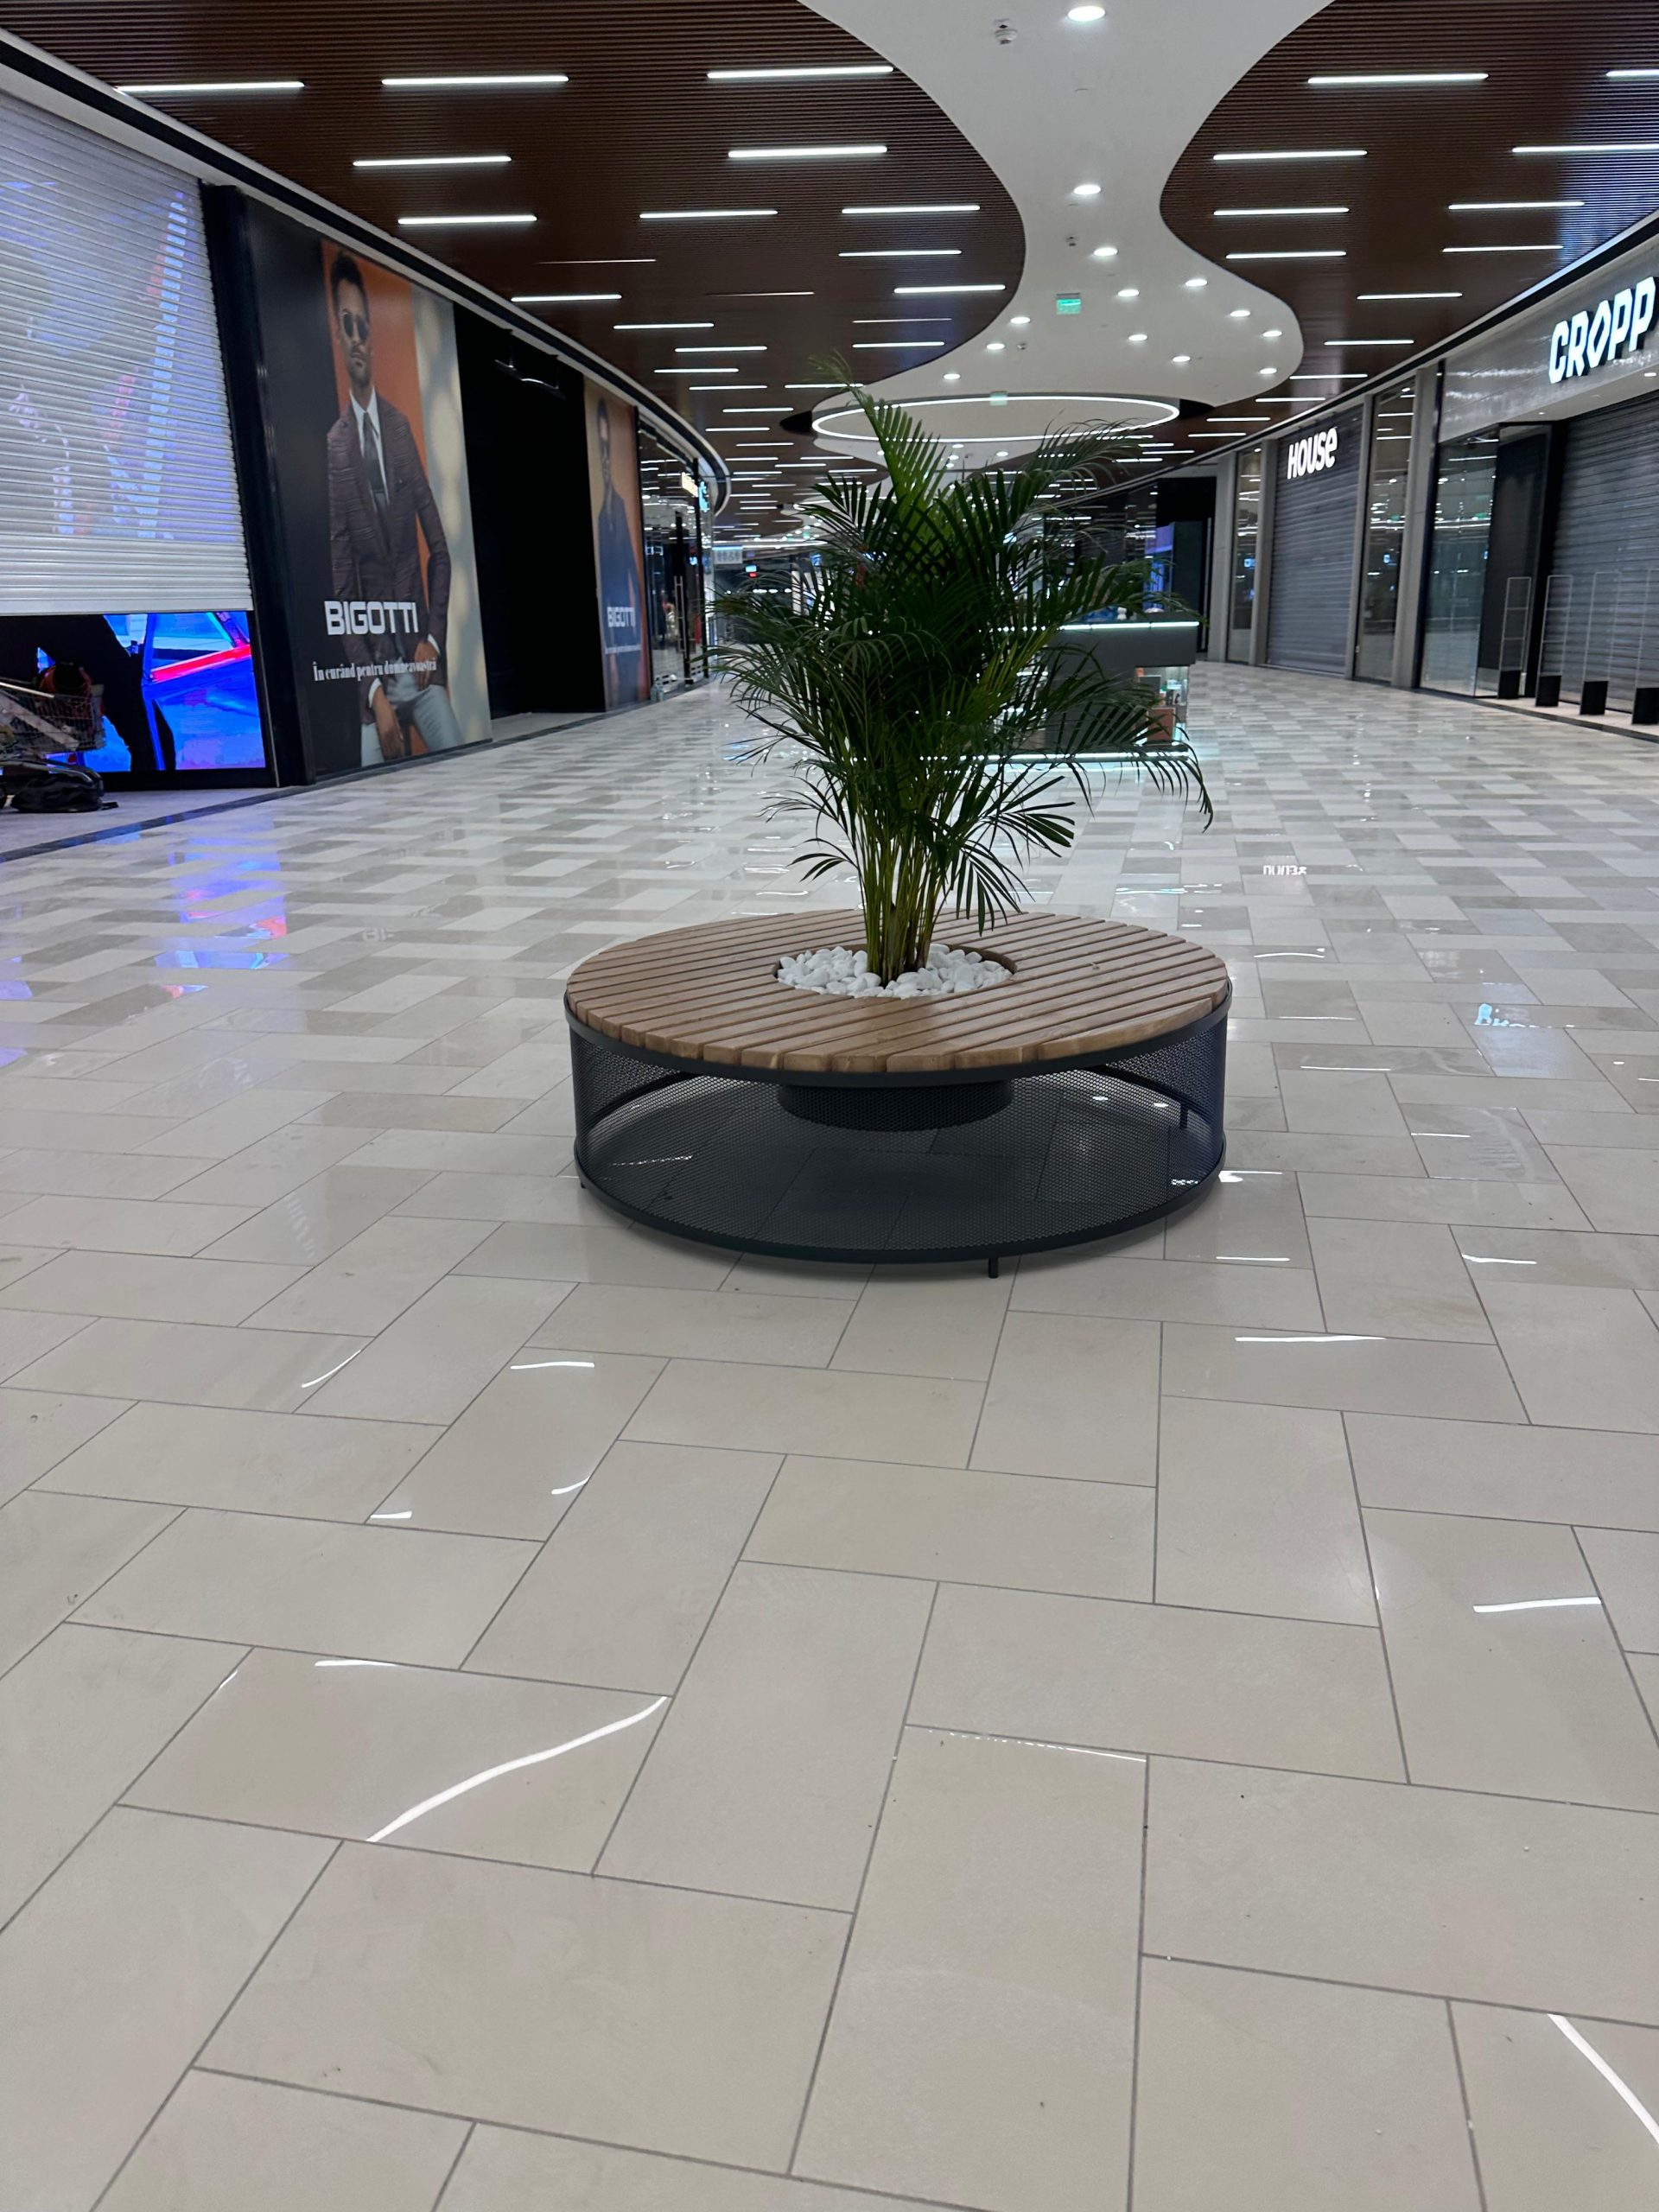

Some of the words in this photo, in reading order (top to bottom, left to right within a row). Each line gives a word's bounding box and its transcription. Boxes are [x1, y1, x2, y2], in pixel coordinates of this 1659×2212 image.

[1548, 276, 1656, 385] CROPP
[324, 601, 419, 635] BIGOTTI
[607, 607, 636, 627] BIGOTTI
[312, 661, 325, 682] În
[325, 663, 356, 680] curând
[356, 662, 384, 682] pentru
